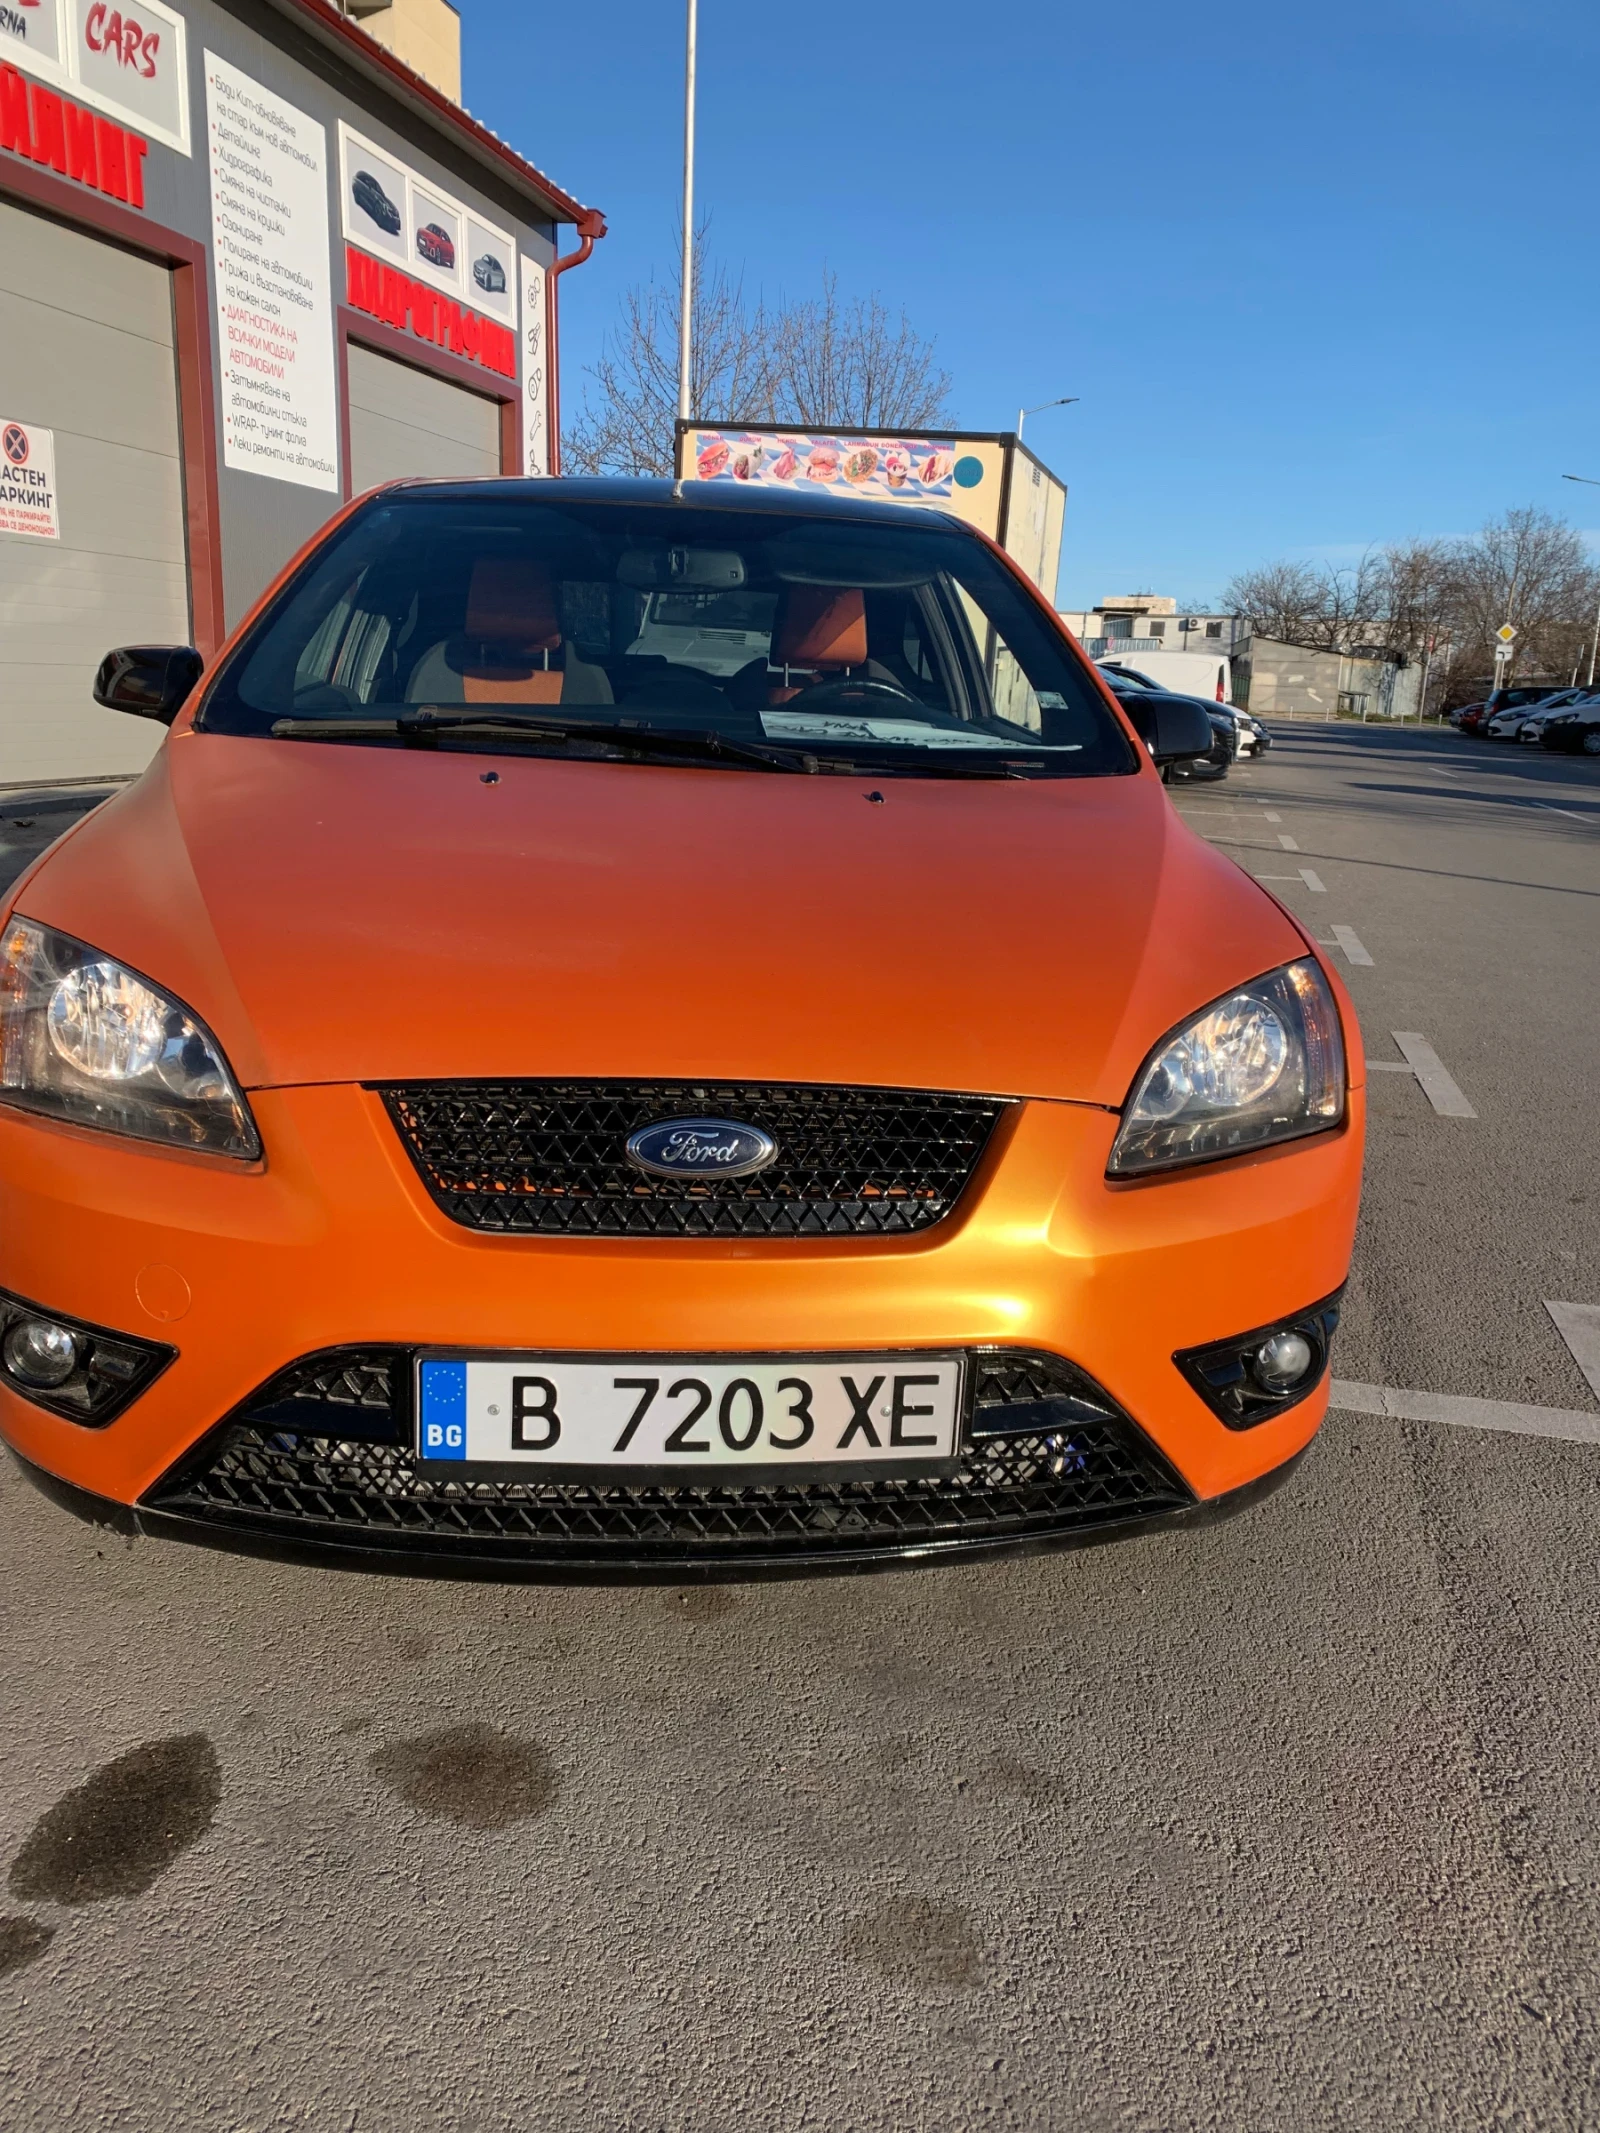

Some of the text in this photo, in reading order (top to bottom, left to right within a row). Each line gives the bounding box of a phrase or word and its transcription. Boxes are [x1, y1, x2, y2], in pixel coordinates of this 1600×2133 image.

[85, 1, 160, 78] CARS
[215, 74, 235, 100] Боди
[216, 101, 318, 172] на стар към нов автомобил
[218, 121, 261, 159] Детайлинг
[218, 144, 273, 187] Хидрографика
[220, 167, 291, 218] Смяна на чистачки
[221, 190, 286, 236] Смяна на крушки
[222, 213, 263, 245] Озониране
[223, 235, 313, 291] Полиране на автомобили
[224, 258, 314, 311] Грижа и възстановяване
[225, 284, 281, 316] на кожен салон
[227, 303, 298, 344] ДИАГНОСТИКА НА
[228, 325, 296, 363] ВСИЧКИ МОДЕЛИ
[229, 347, 285, 379] АВТОМОБИЛИ
[230, 369, 291, 402] Затъмняване на
[231, 392, 307, 428] автомобилни стъкла
[260, 424, 284, 439] тунинг
[233, 434, 335, 474] Леки ремонти на автомобили
[0, 464, 46, 488] АСТЕН
[661, 1130, 739, 1162] Ford
[510, 1374, 941, 1453] B 7203 XE
[427, 1423, 463, 1448] BG
